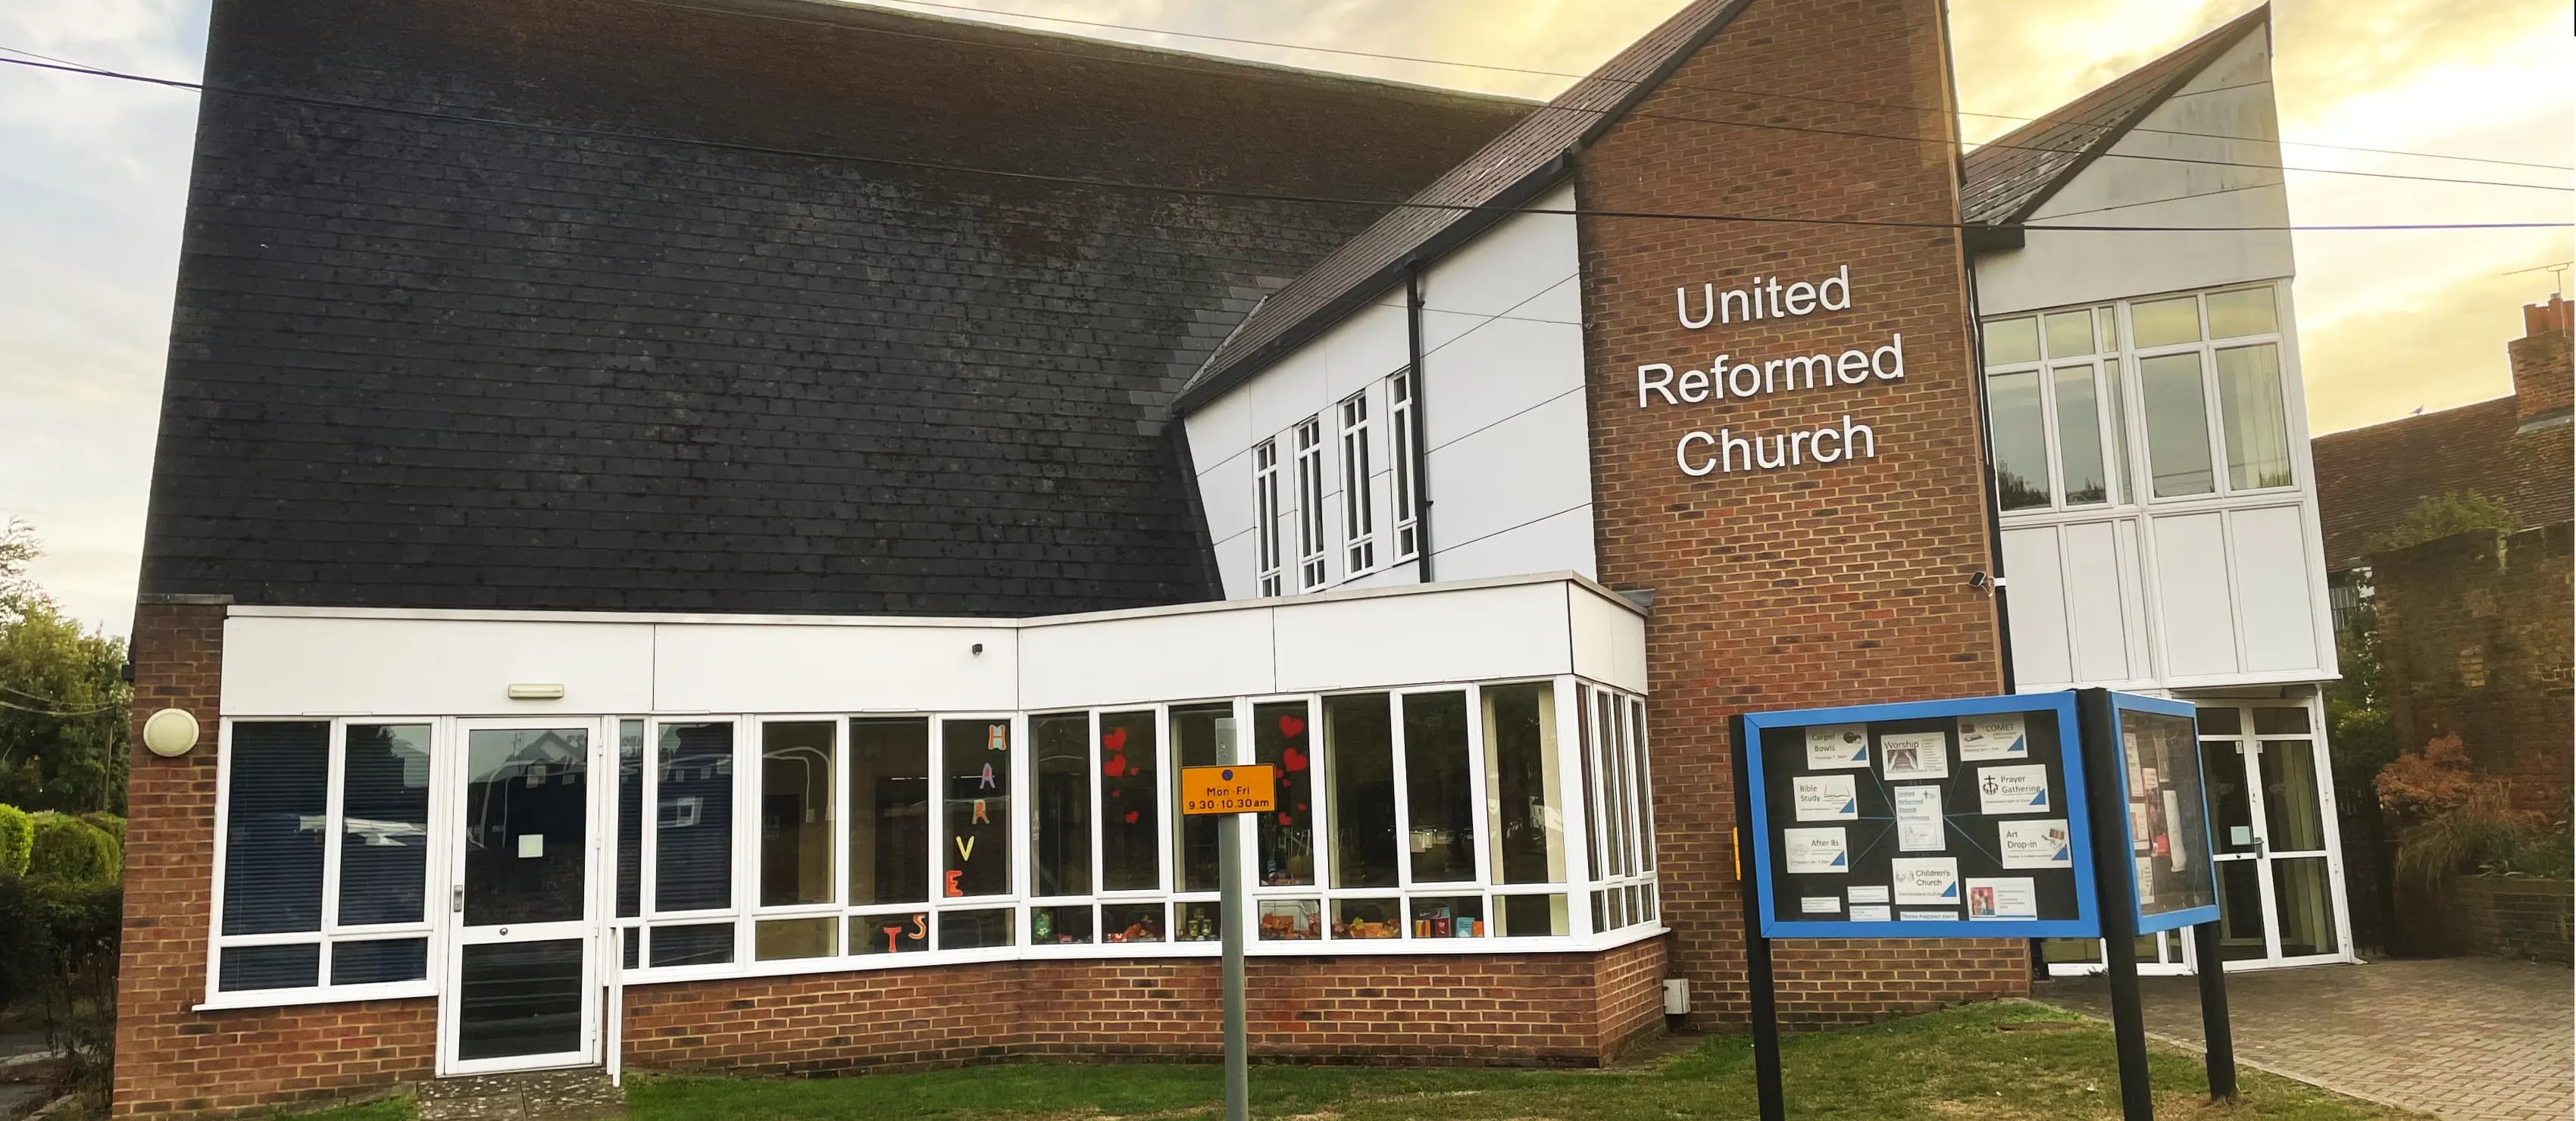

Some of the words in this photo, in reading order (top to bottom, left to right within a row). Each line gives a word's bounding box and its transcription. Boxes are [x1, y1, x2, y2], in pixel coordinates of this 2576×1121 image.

[1676, 264, 1852, 329] United
[1637, 333, 1905, 409] Reformed
[1675, 414, 1875, 476] Church
[1986, 723, 2014, 732] COMET
[1812, 733, 1836, 742] Carpet
[1815, 744, 1835, 752] Bowls
[1884, 740, 1919, 749] Worship
[2000, 776, 2026, 784] Prayer
[2001, 785, 2040, 794] Gathering
[1800, 795, 1820, 803] Study
[2007, 841, 2037, 849] Drop-in
[1915, 869, 1951, 877] Children's
